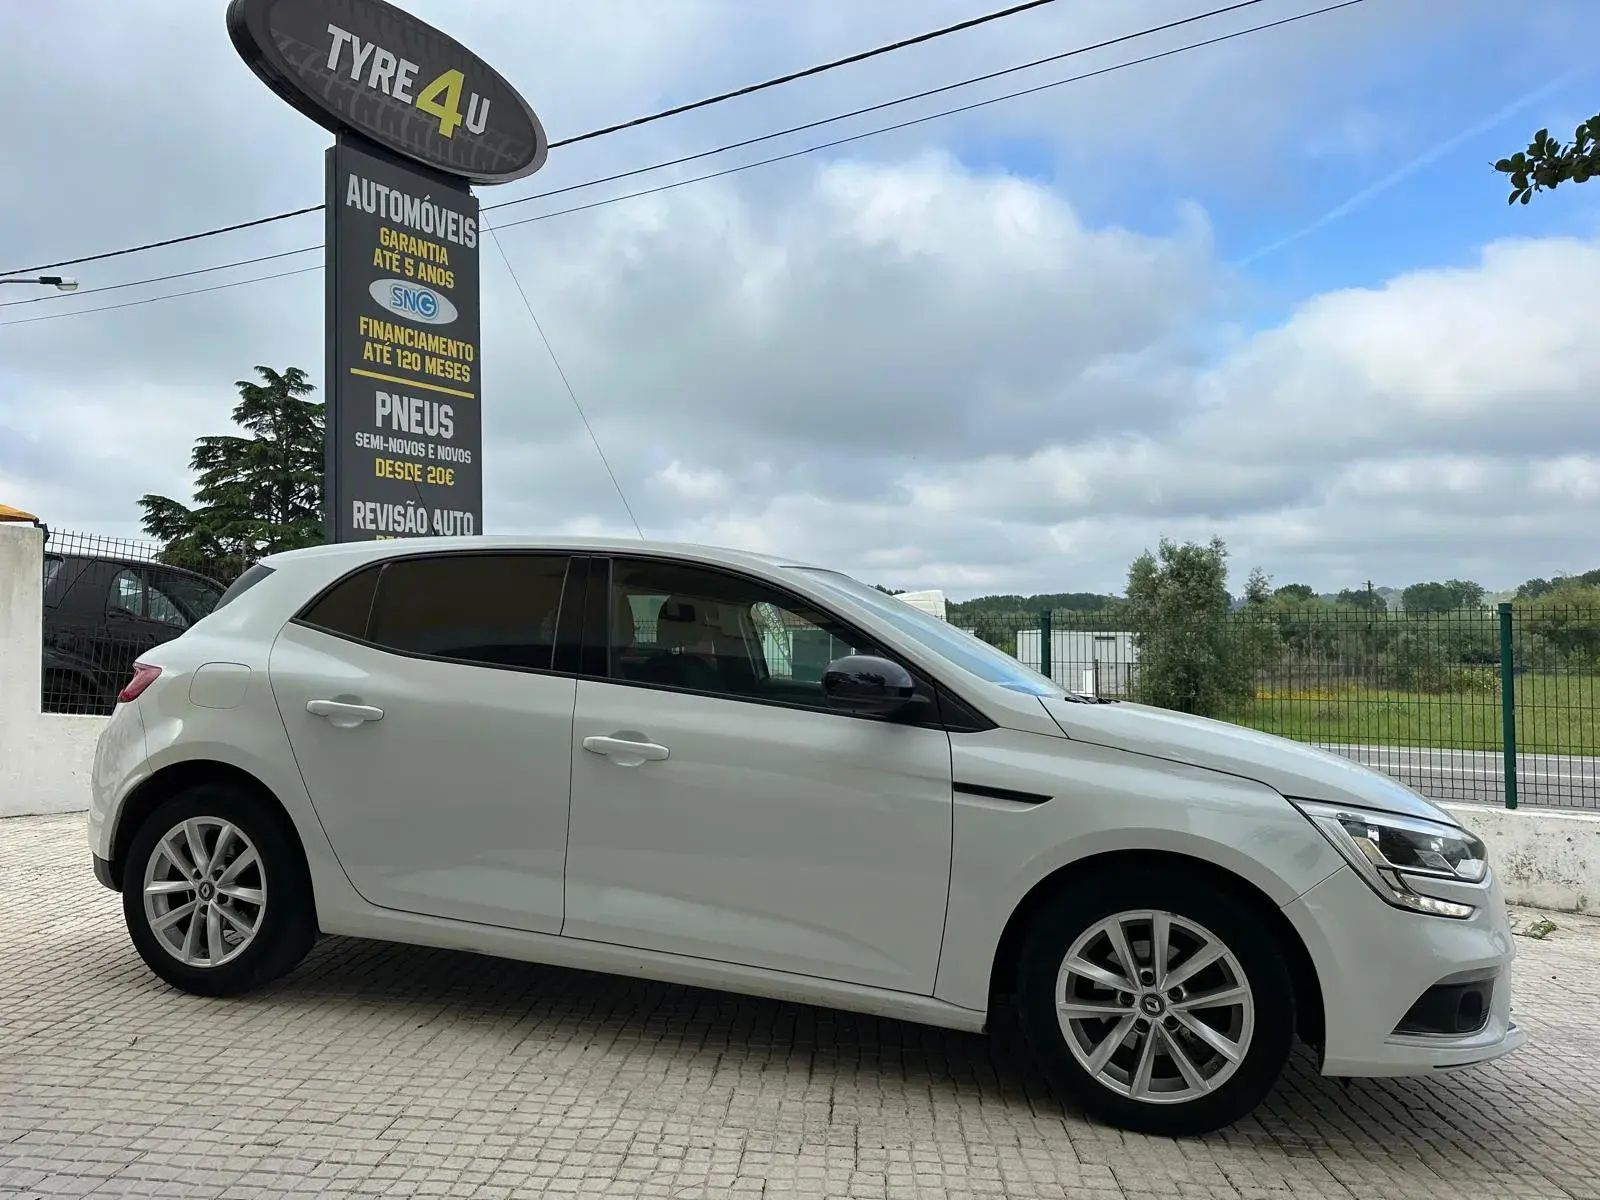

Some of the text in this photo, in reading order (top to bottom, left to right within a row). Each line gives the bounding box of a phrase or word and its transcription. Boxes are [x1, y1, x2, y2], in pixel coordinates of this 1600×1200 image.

[346, 173, 477, 249] AUTOMÓVEIS
[379, 227, 449, 266] GARANTIA
[373, 247, 455, 289] ATÉ 5 ANOS
[390, 284, 439, 320] SNG
[359, 316, 474, 362] FINANCIAMENTO
[363, 342, 471, 383] ATÉ 120 MESES
[375, 390, 454, 439] PNEUS
[355, 431, 472, 464] SEMI-NOVOS E NOVOS
[375, 457, 455, 486] DESDE 20€
[352, 499, 474, 537] REVISÃO AUTO
